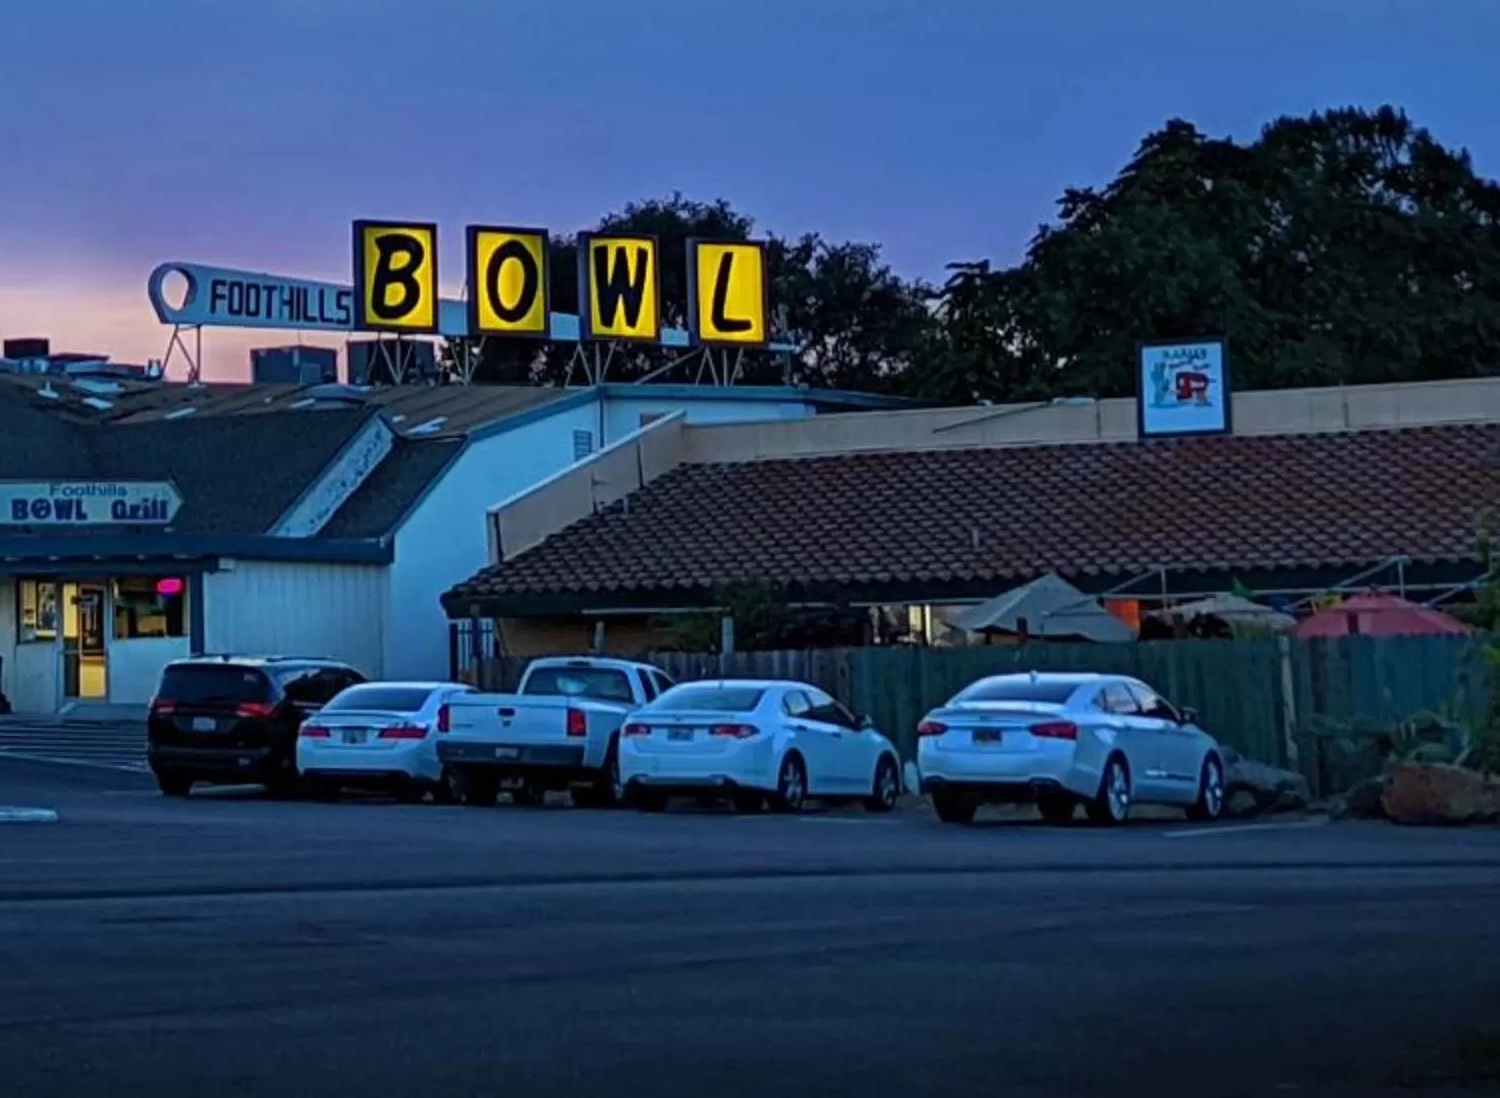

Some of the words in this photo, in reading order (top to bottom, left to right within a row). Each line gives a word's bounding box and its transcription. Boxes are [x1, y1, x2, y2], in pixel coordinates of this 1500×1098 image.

[209, 278, 351, 325] FOOTHILLS
[371, 232, 754, 334] BOWL
[50, 484, 128, 498] Foothills
[11, 498, 88, 520] BOWL
[111, 494, 169, 520] Grill
